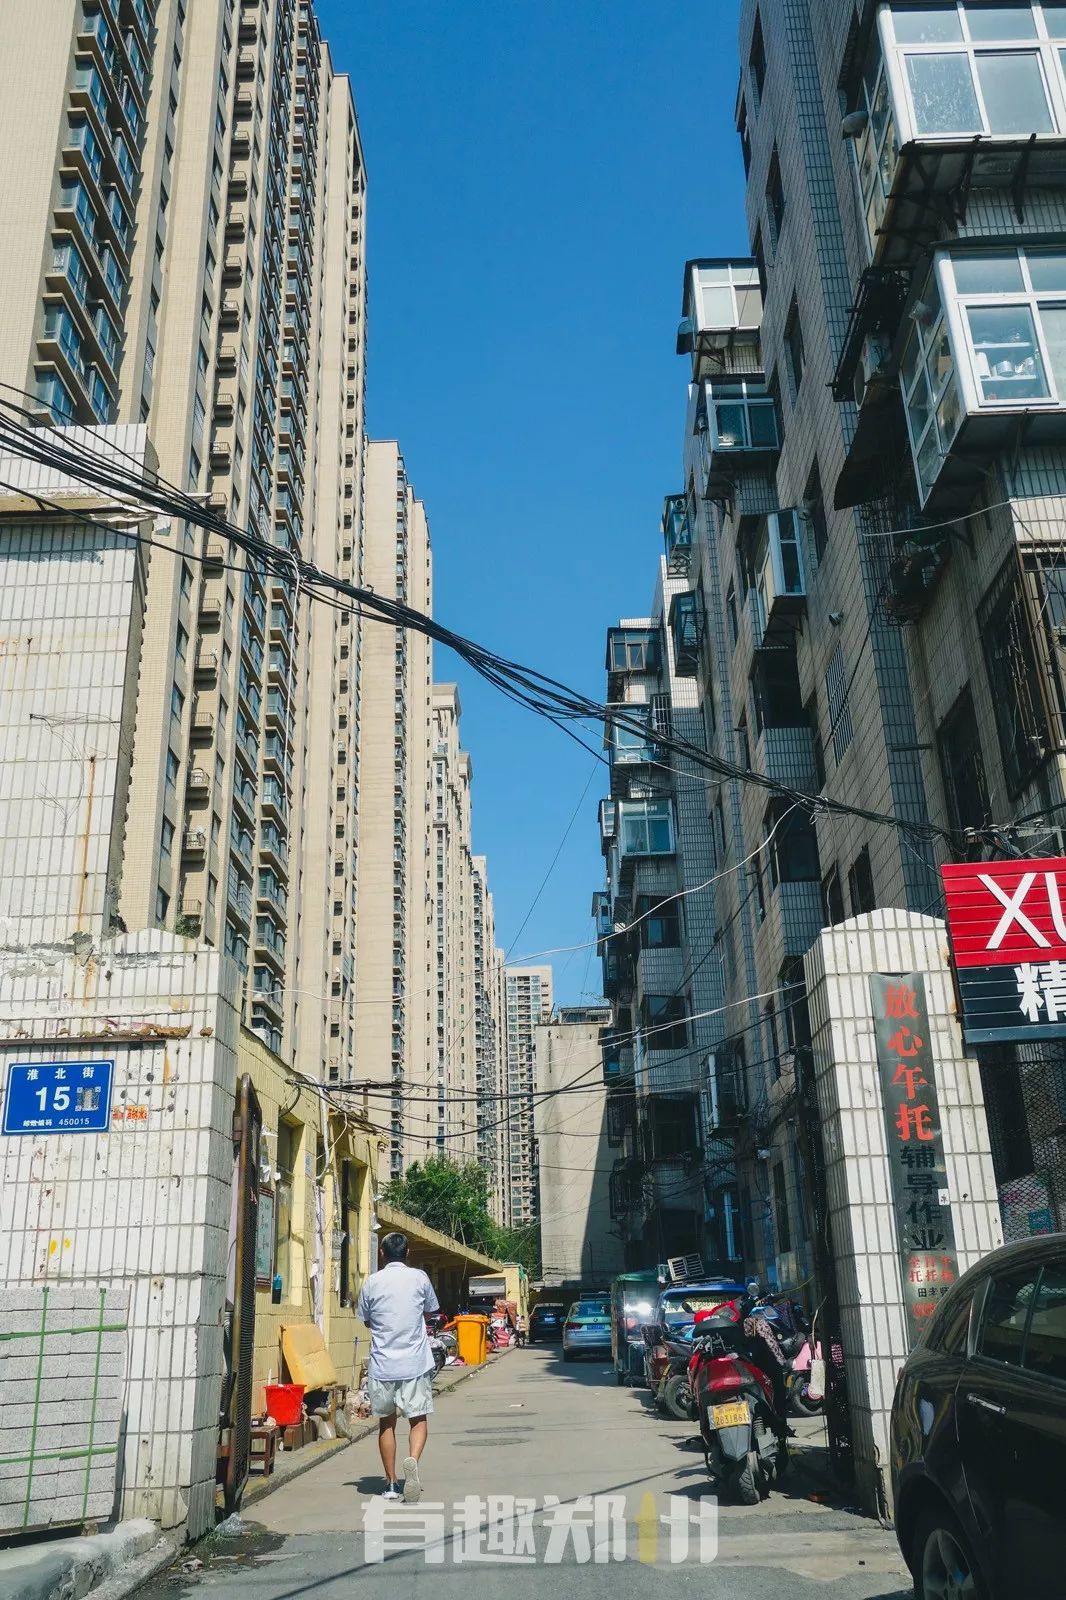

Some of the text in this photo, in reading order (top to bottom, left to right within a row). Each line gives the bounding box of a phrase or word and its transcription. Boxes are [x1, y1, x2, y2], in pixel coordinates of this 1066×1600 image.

[1014, 960, 1066, 1022] 精
[27, 1066, 95, 1081] 淮北街
[884, 984, 934, 1141] 放心午托
[35, 1086, 71, 1112] 15
[58, 1117, 90, 1126] 450015
[900, 1146, 947, 1251] 辅导作业
